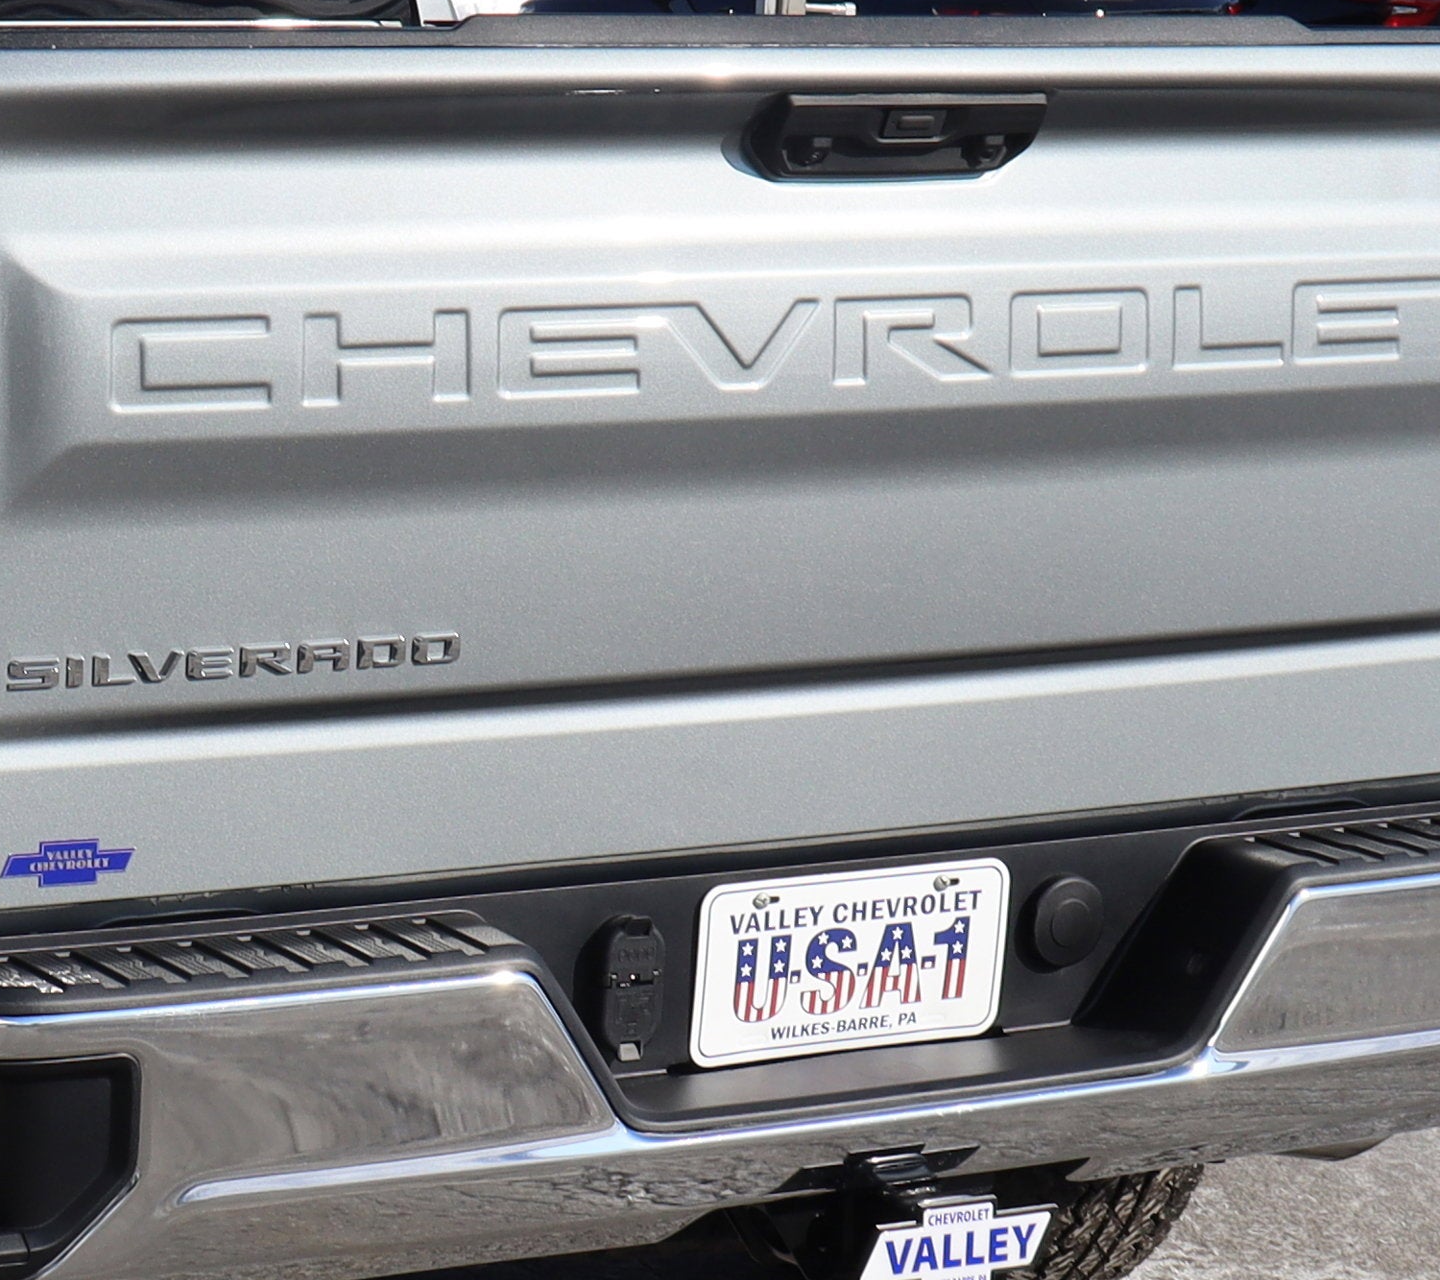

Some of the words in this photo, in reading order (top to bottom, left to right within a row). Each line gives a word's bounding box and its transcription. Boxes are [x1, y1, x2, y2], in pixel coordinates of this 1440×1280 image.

[5, 631, 461, 692] SILVERADO
[29, 857, 110, 873] CHEVROLET
[46, 849, 94, 861] VALLEY
[730, 905, 824, 935] VALLEY
[833, 889, 983, 924] CHEVROLET
[770, 1014, 893, 1041] WILKES-BARRE,
[898, 1012, 917, 1026] PA
[928, 1208, 990, 1227] CHEVROLET
[886, 1223, 1038, 1275] VALLEY
